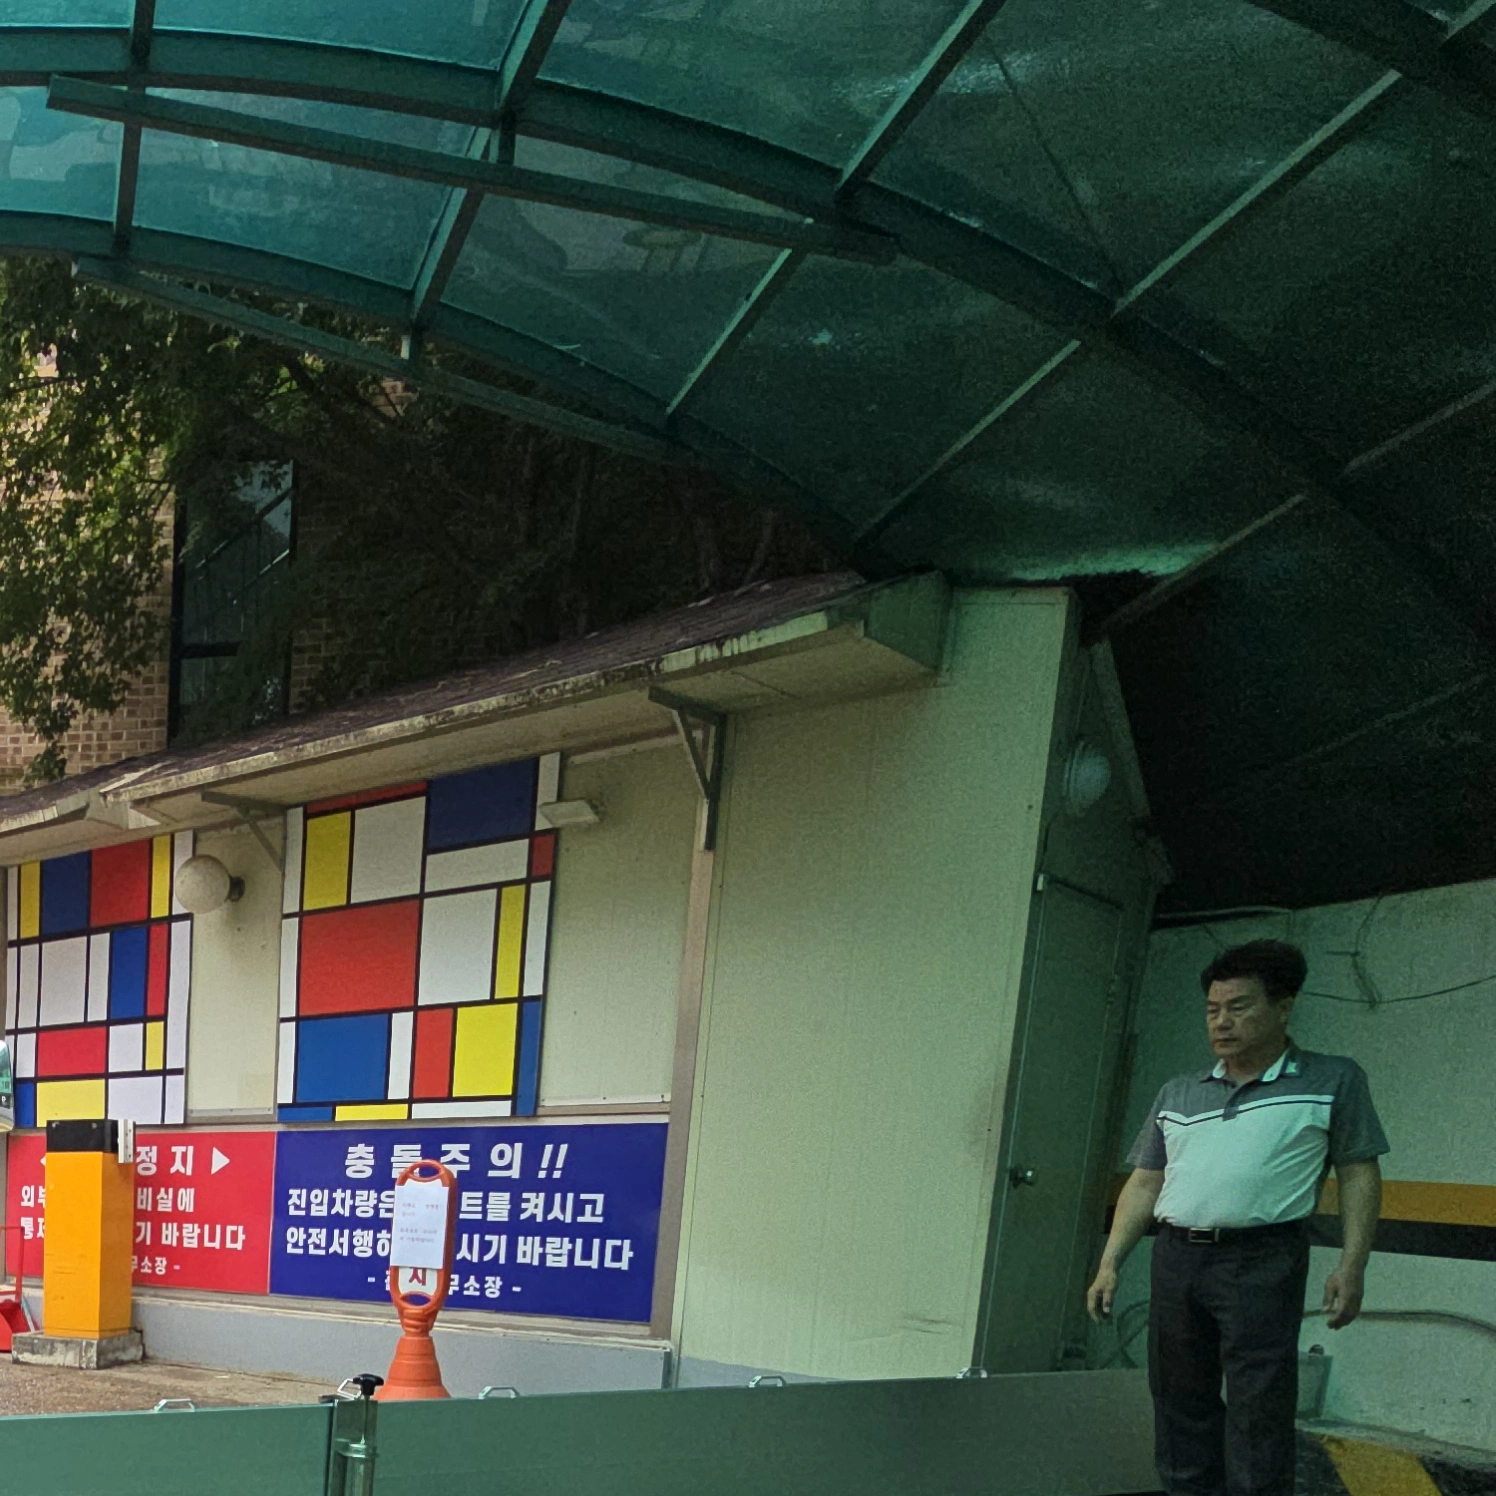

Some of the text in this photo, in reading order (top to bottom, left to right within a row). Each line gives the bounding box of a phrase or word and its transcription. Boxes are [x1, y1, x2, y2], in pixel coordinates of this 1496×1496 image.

[288, 1188, 395, 1218] 진입차량은
[520, 1192, 604, 1223] 켜시고
[161, 1222, 245, 1250] 바랍니다
[516, 1236, 634, 1270] 바랍니다
